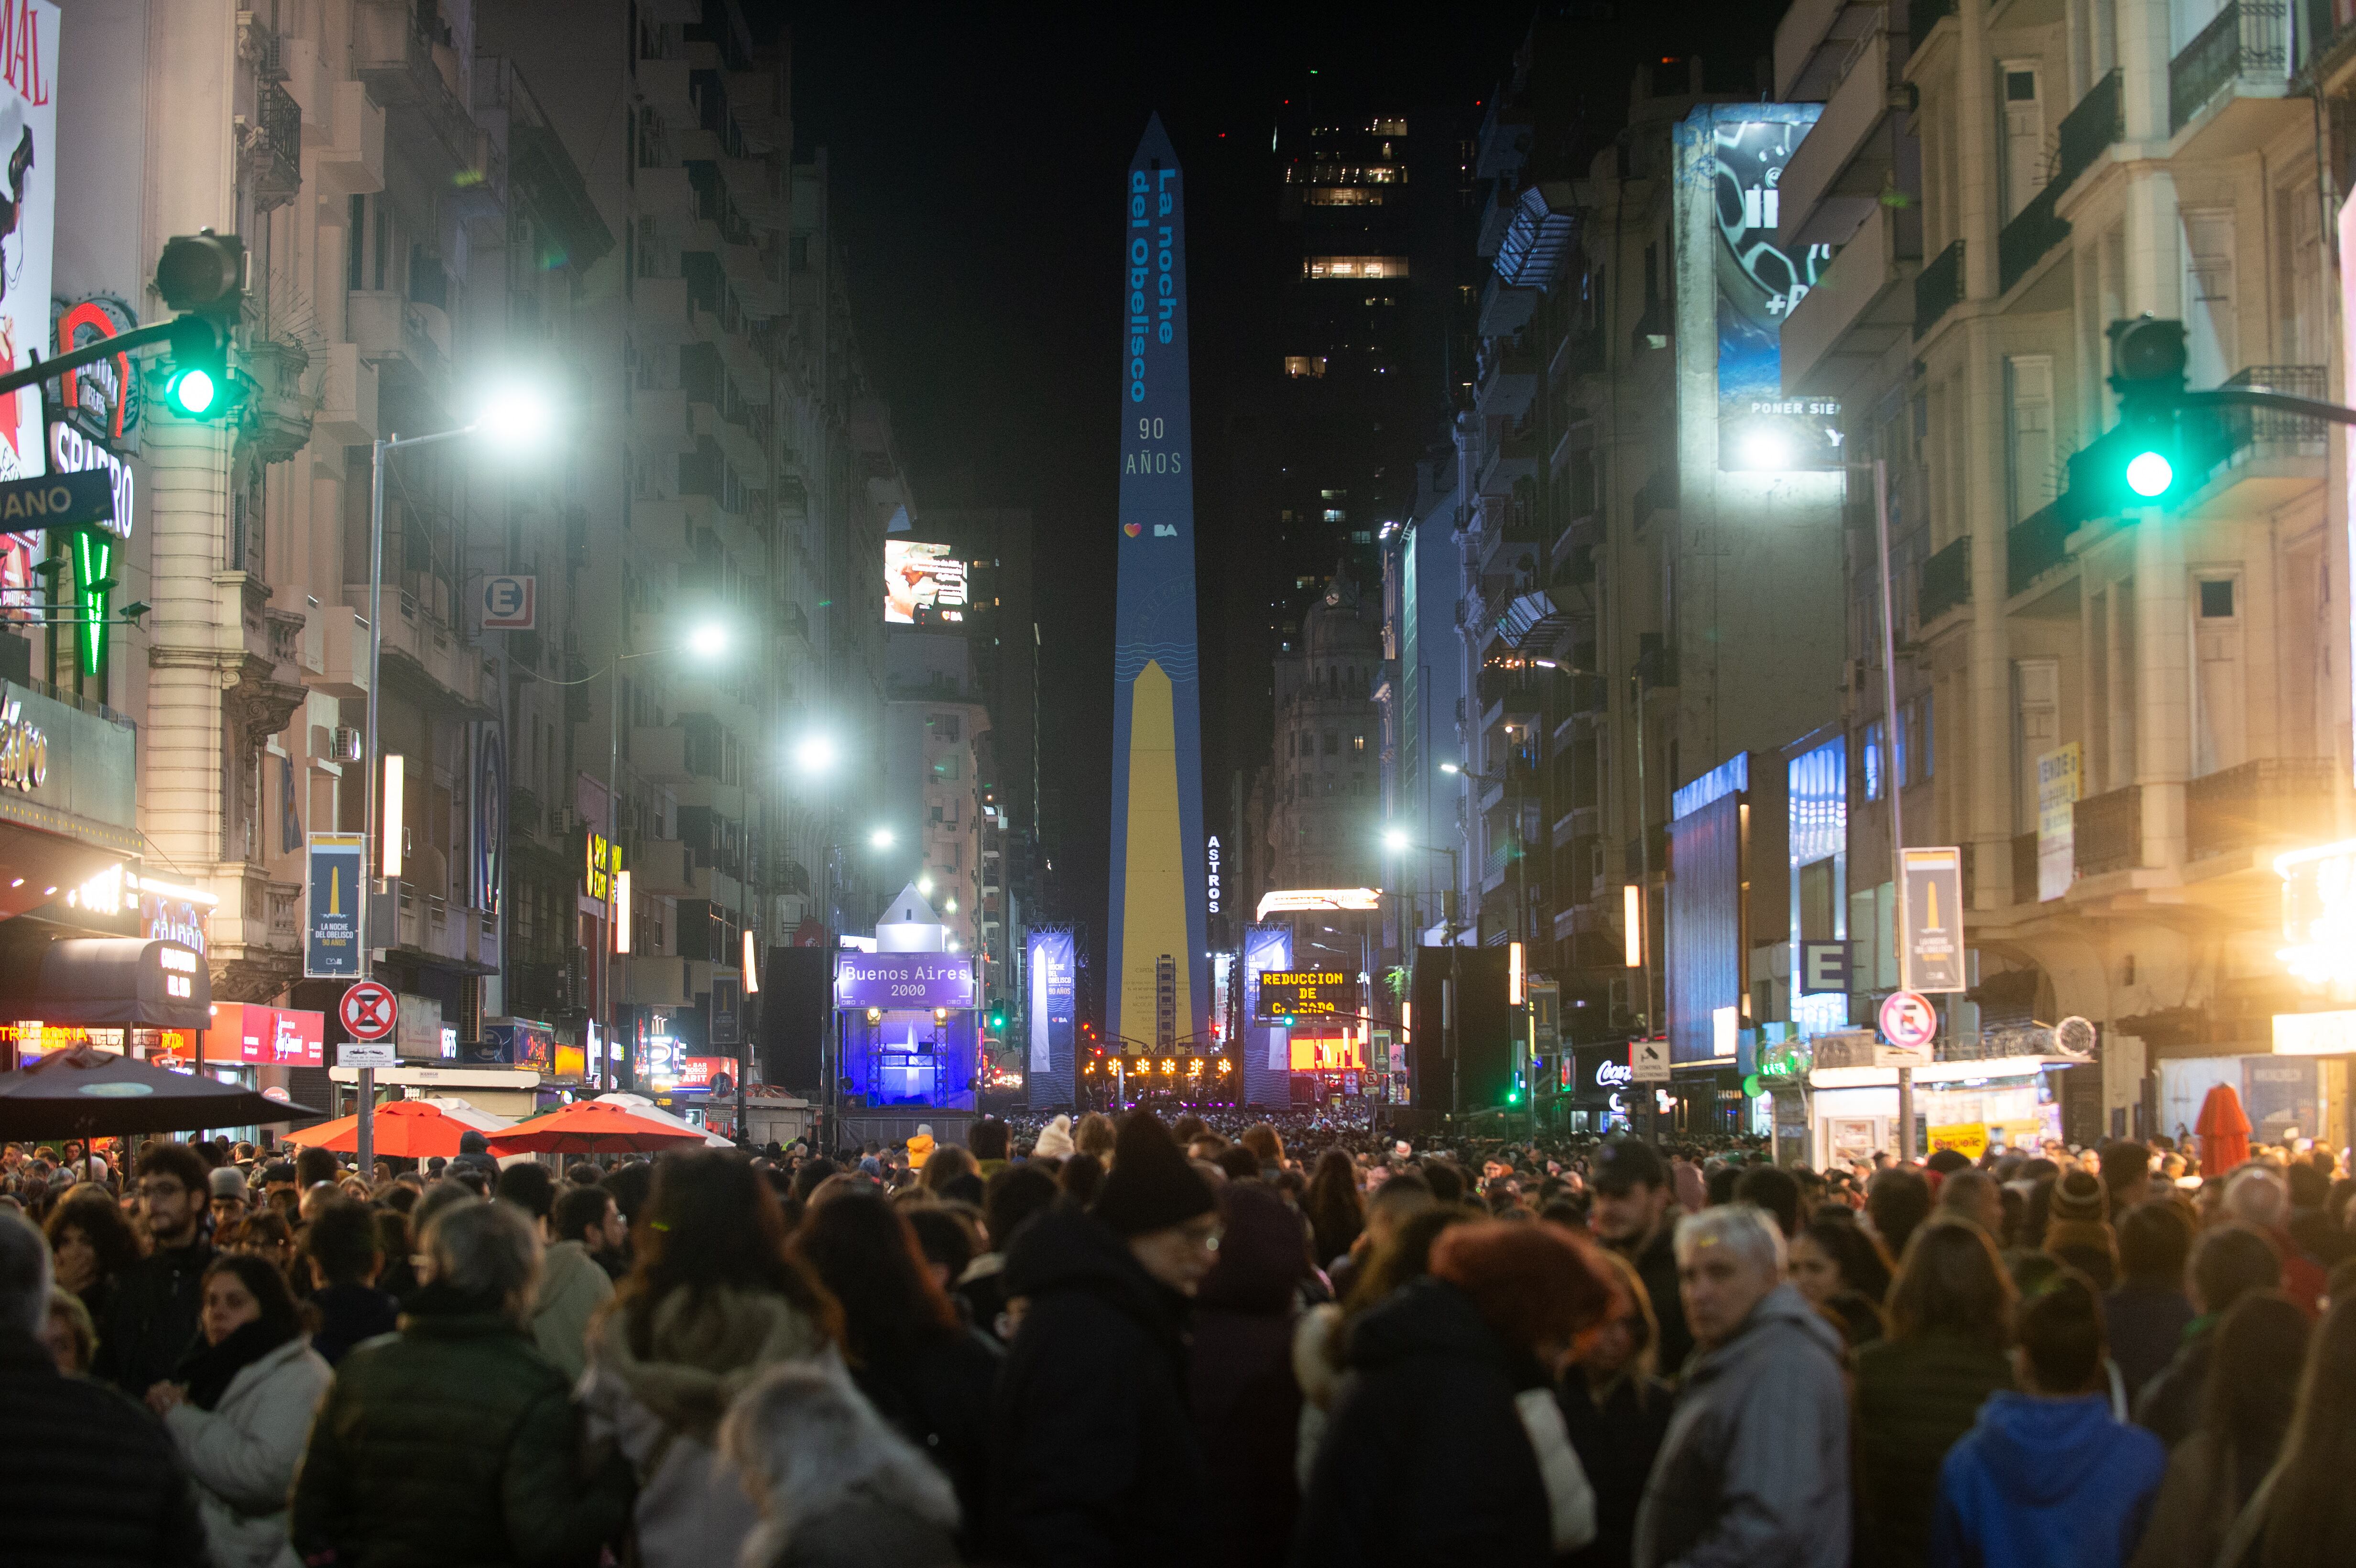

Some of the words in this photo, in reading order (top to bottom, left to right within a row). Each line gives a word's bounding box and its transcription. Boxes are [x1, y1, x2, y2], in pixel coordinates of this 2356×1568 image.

[1132, 171, 1149, 228] del
[1158, 169, 1176, 217] La
[1158, 227, 1177, 344] noche
[1131, 238, 1149, 402] Obelisco
[1751, 403, 1803, 414] PONER
[1140, 418, 1164, 439] 90
[1126, 450, 1181, 474] AÑOS
[0, 487, 71, 520] ANO
[1154, 524, 1178, 537] BA
[492, 583, 515, 612] E
[1208, 836, 1220, 913] ASTROS
[845, 966, 908, 980] Buenos
[915, 966, 967, 980] Aires
[1807, 945, 1845, 989] E
[891, 984, 926, 996] 2000
[1263, 973, 1343, 985] REDUCCION
[1299, 988, 1317, 999] DE
[1272, 1002, 1335, 1013] CZADA
[0, 1027, 87, 1043] TRATTORIA
